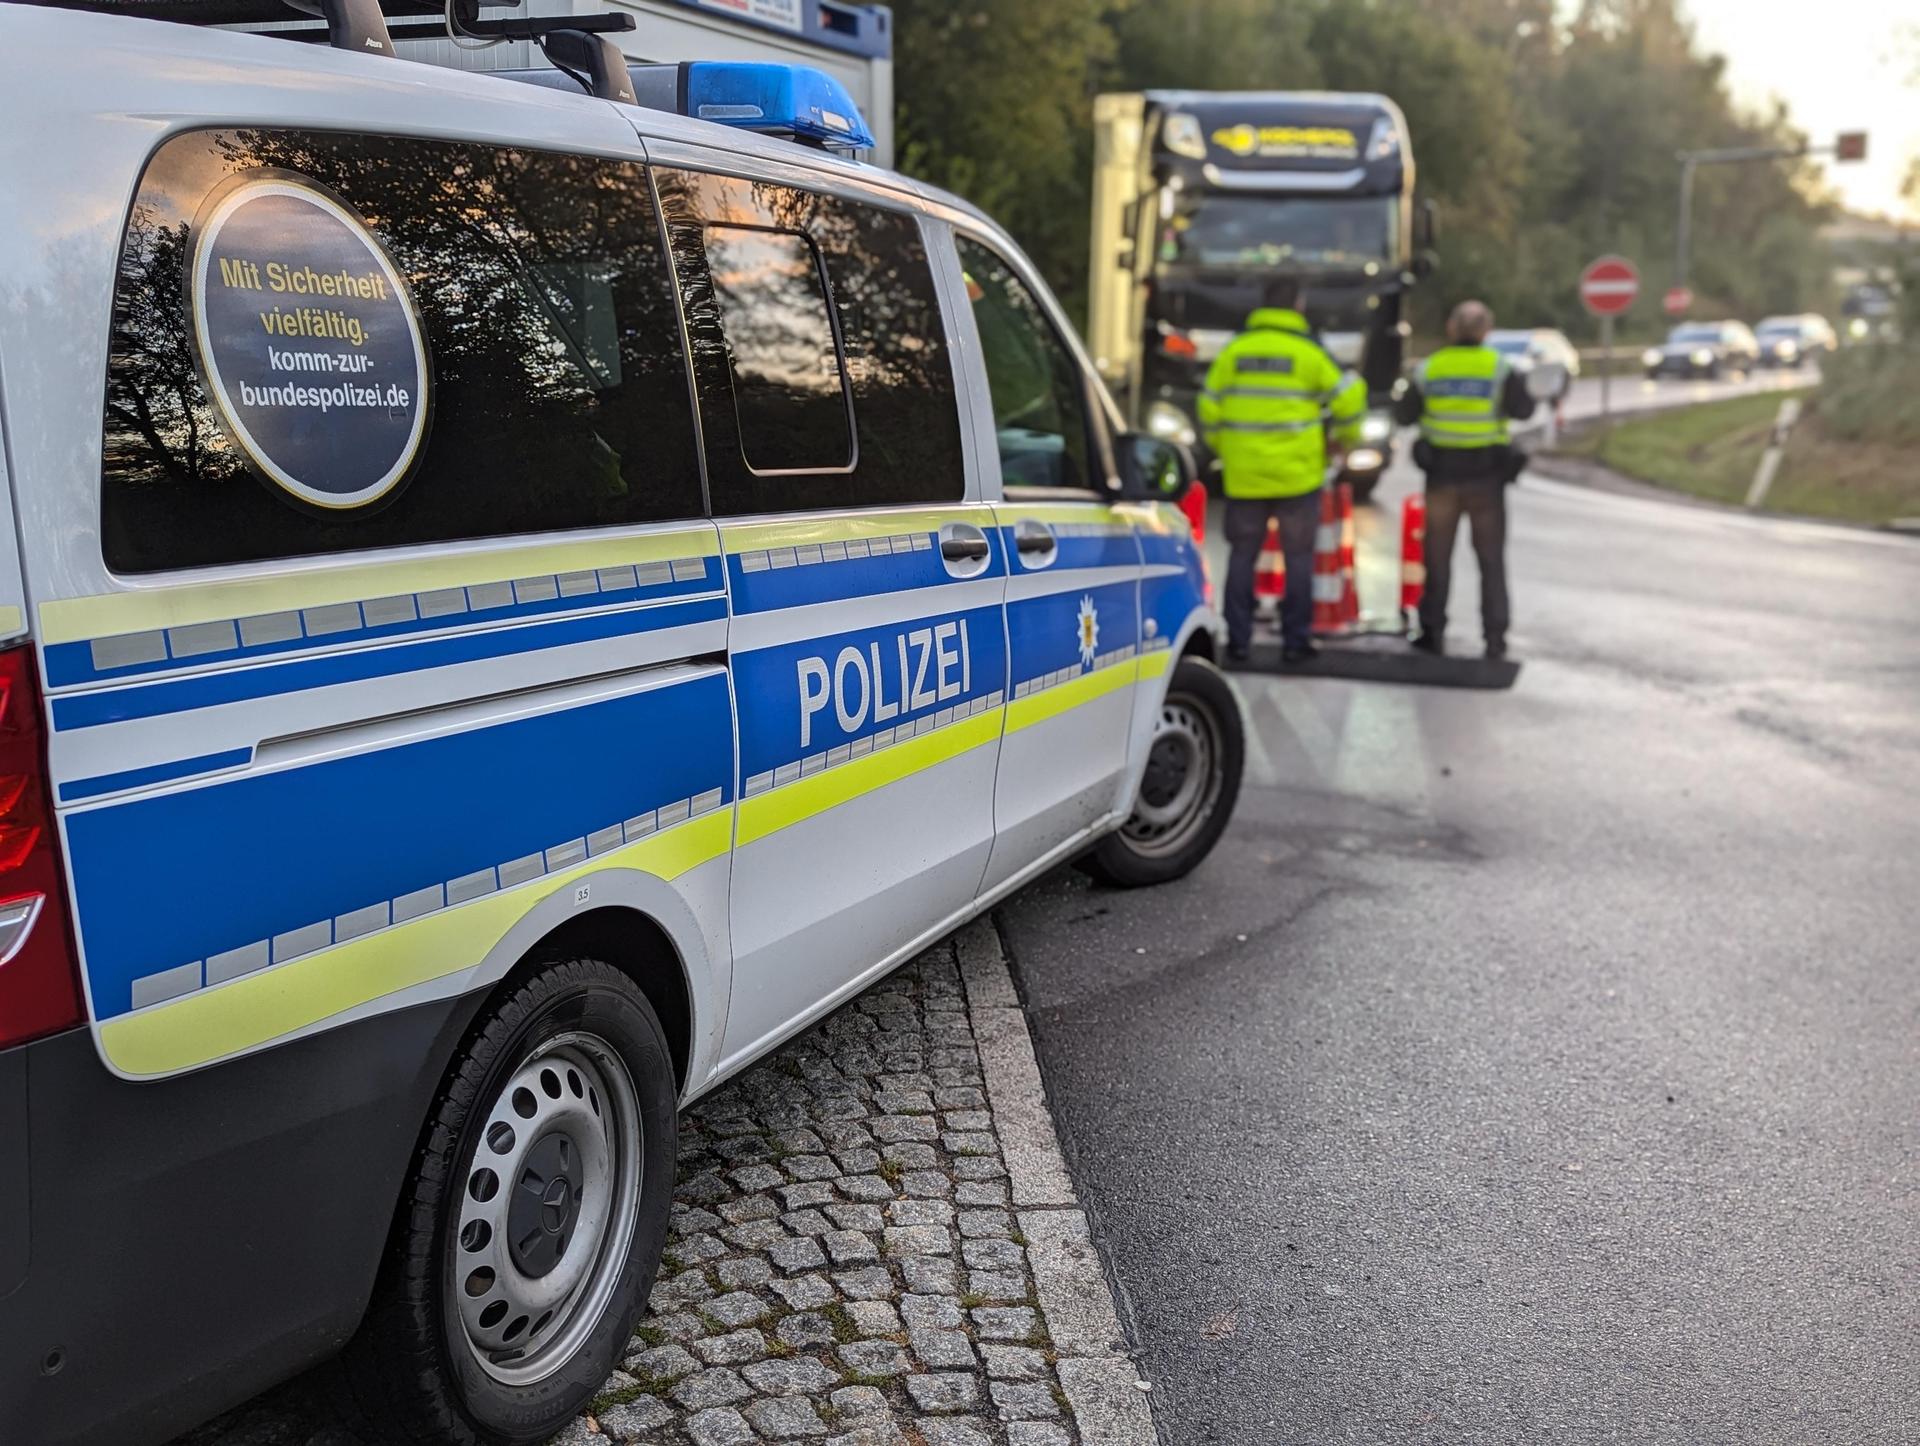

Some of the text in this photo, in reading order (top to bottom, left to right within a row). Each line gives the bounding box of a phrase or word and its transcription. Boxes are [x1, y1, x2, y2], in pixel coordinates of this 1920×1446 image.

[219, 257, 387, 300] Mit Sicherheit
[260, 306, 369, 346] vielfältig.
[268, 345, 374, 373] komm-zur-
[239, 380, 410, 413] bundespolizei.de
[797, 619, 970, 748] POLIZEI
